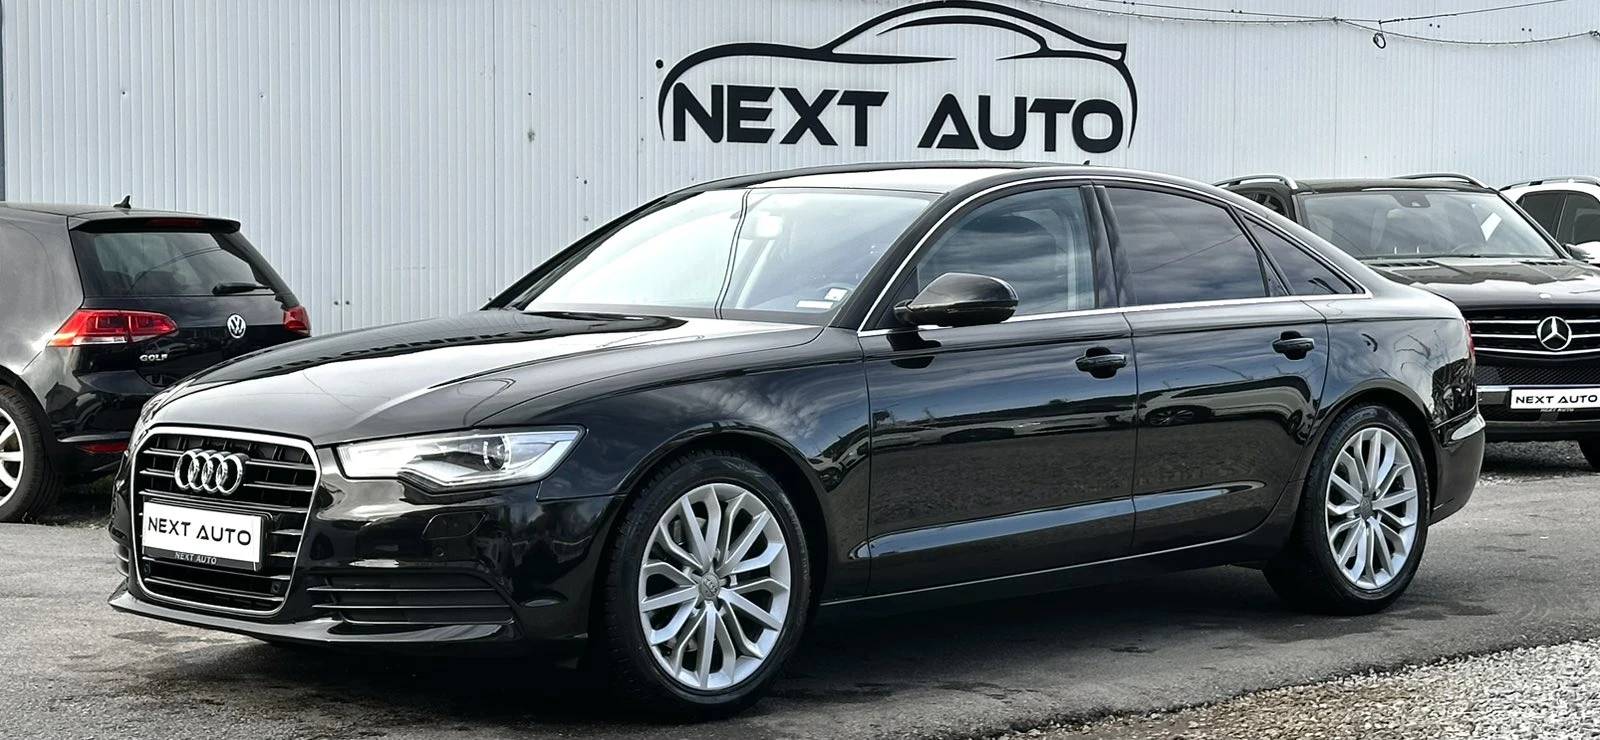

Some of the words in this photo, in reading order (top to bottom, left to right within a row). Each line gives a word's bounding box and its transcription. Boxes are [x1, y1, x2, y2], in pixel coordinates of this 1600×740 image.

[672, 81, 890, 147] NEXT
[917, 92, 1125, 154] AUTO
[139, 353, 168, 362] GOLF
[1515, 395, 1555, 404] NEXT
[1558, 394, 1598, 404] AUTO
[147, 516, 192, 537] NEXT
[196, 524, 252, 546] AUTO
[174, 551, 194, 562] NEXT
[196, 555, 218, 565] AUTO
